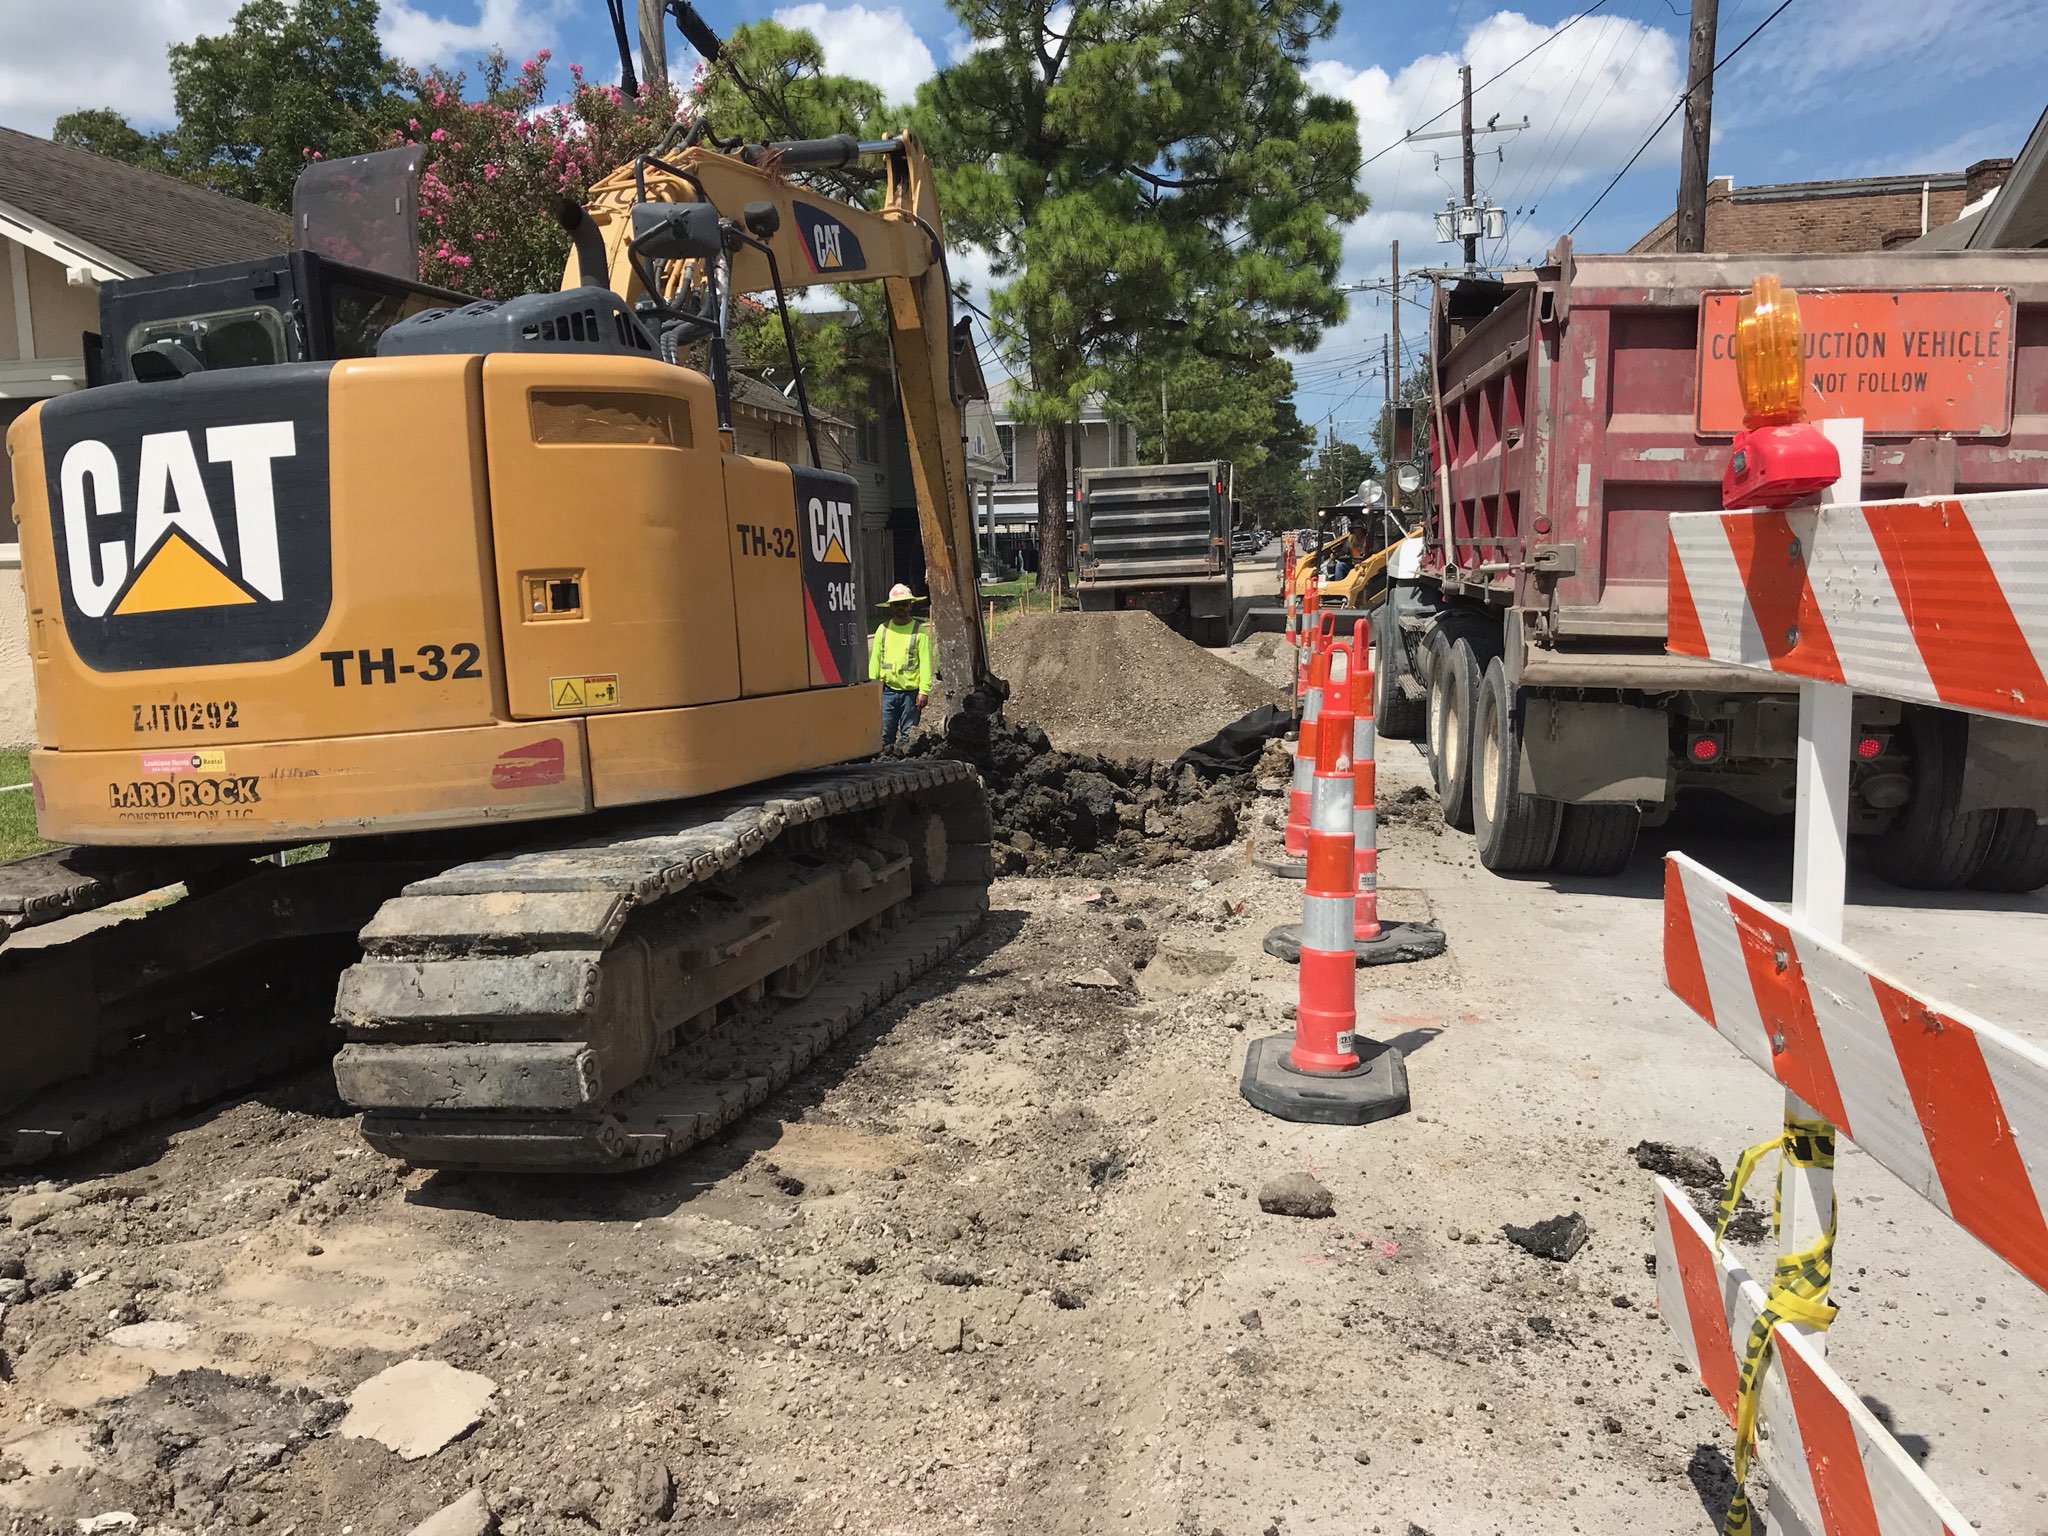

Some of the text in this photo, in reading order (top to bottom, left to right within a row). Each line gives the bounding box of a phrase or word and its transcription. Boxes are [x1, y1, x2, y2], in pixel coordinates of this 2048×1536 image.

[813, 224, 843, 268] CAT
[1712, 330, 2000, 359] COUCTION VEHICLE
[1813, 371, 1928, 393] NOT FOLLOW
[60, 420, 297, 618] CAT
[808, 497, 853, 564] CAT
[736, 524, 797, 559] TH-32
[827, 581, 857, 612] 314E
[320, 642, 483, 687] TH-32
[132, 700, 239, 732] ZJT0292
[109, 776, 262, 808] HARD ROCK
